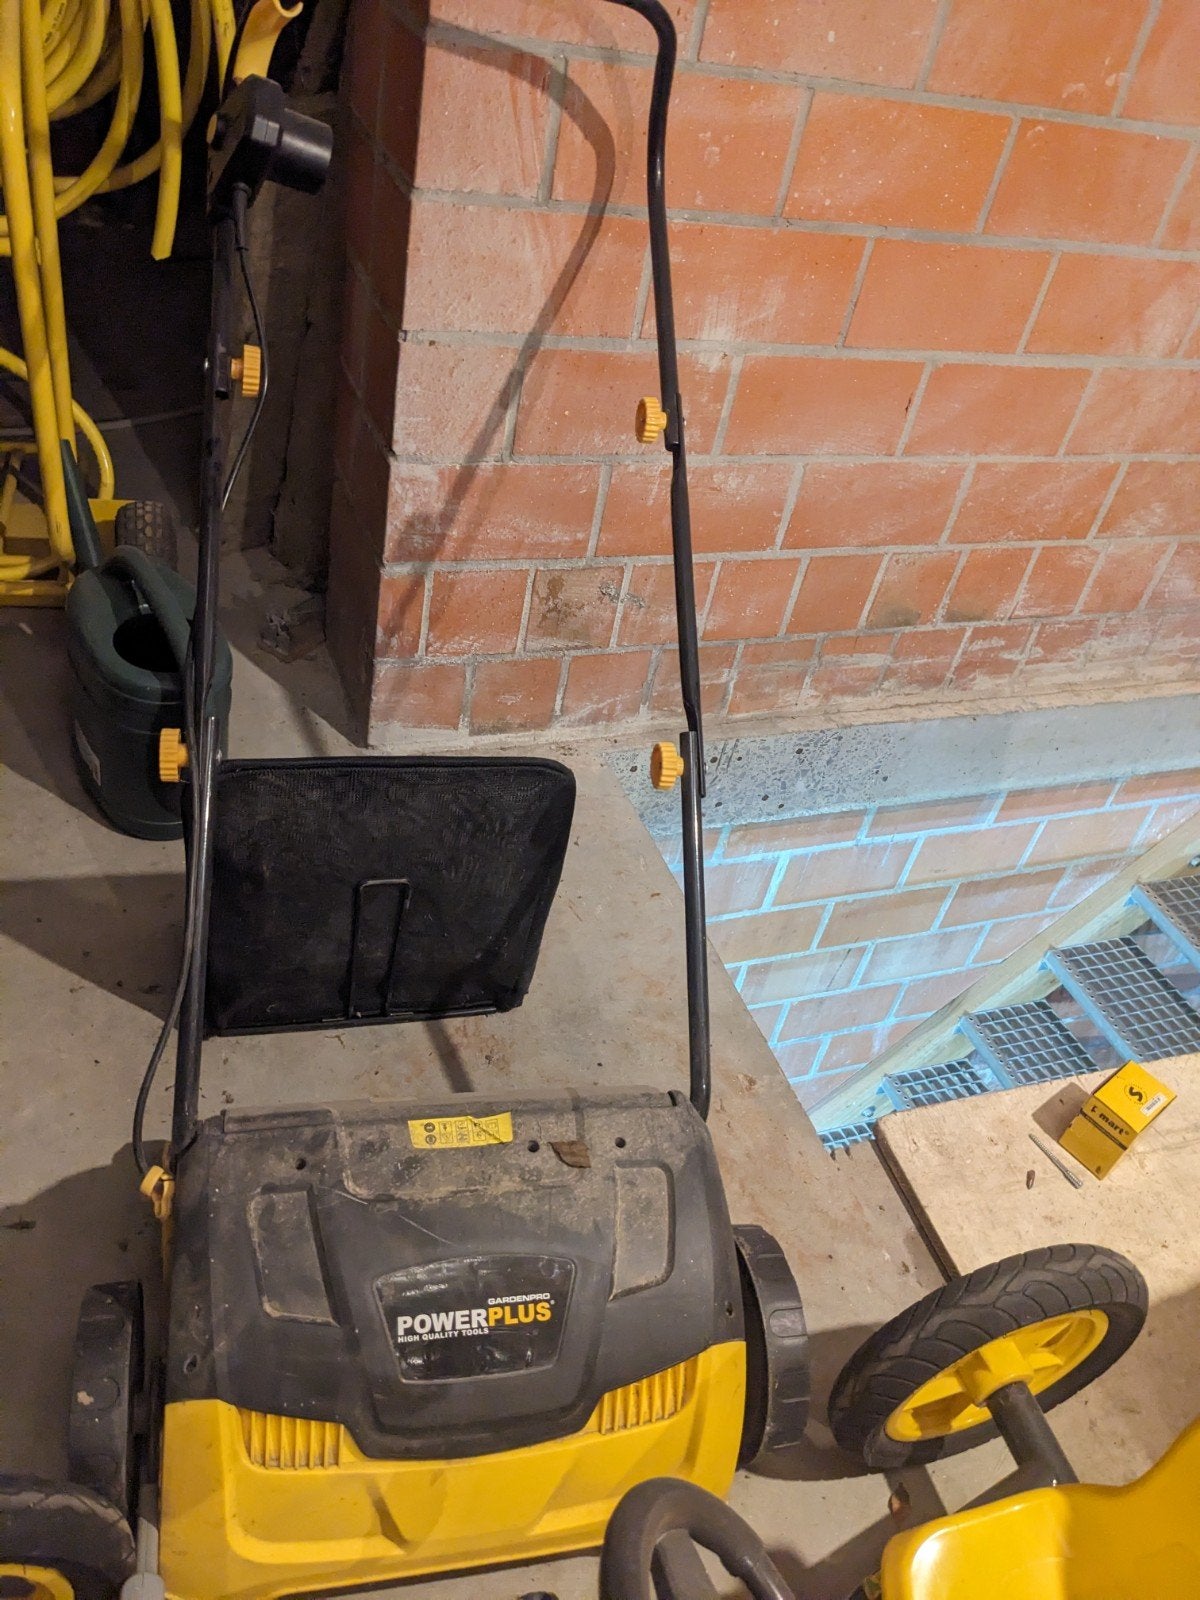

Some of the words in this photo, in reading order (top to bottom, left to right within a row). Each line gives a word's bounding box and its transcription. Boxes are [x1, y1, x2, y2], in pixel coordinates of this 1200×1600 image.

[487, 1292, 551, 1305] GARDENPRO
[398, 1332, 420, 1343] HIGH
[422, 1330, 460, 1341] QUALITY
[461, 1327, 489, 1337] TOOLS
